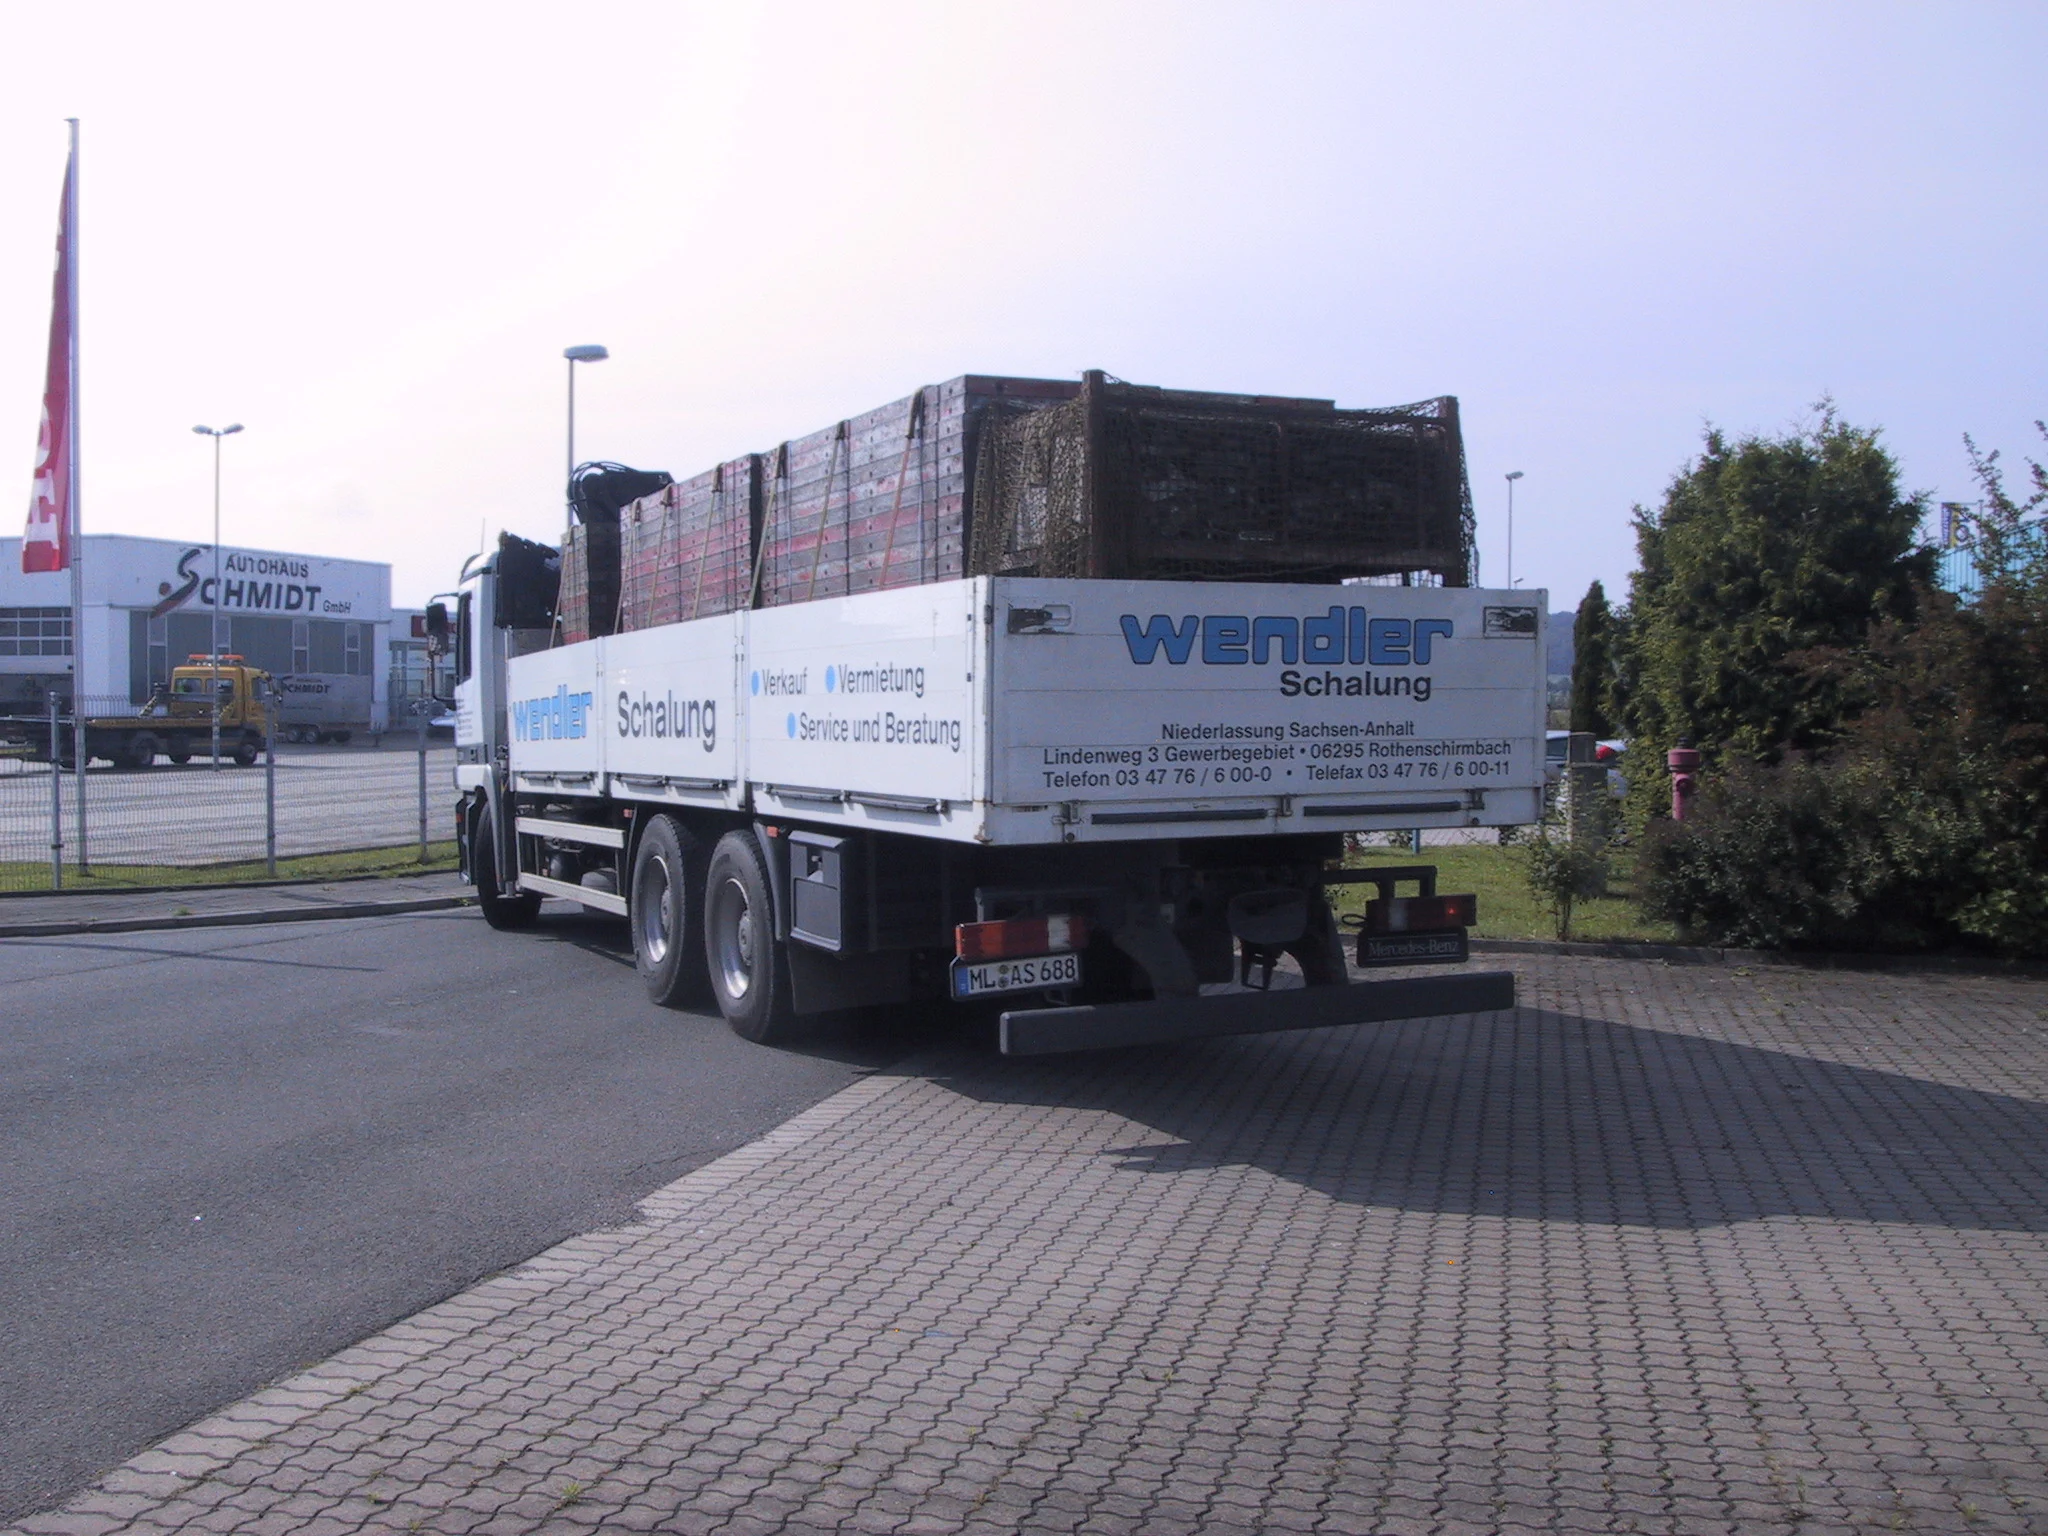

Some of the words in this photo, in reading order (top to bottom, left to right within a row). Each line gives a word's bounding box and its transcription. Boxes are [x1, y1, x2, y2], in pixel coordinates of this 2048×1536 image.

[225, 553, 310, 578] AUTOHAUS
[150, 546, 322, 620] SCHMIDT
[323, 600, 352, 614] GmbH
[1119, 606, 1454, 666] wendler
[762, 666, 808, 696] Verkauf
[838, 662, 925, 699] Vermietung
[1279, 670, 1432, 702] Schalung
[513, 683, 593, 742] wendler
[617, 689, 716, 753] Schalung
[799, 711, 849, 743] Service
[852, 712, 880, 742] und
[884, 712, 961, 753] Beratung
[1161, 723, 1285, 741] Niederlassung
[1289, 720, 1415, 738] Sachsen-Anhalt
[1043, 748, 1143, 767] Lindenweg
[1147, 746, 1159, 763] 3
[1164, 744, 1295, 764] Gewerbegebiet
[1310, 742, 1364, 759] 06295
[1369, 739, 1512, 758] Rothenschirmbach
[1043, 770, 1110, 788] Telefon
[1115, 769, 1139, 786] 03
[1145, 768, 1168, 785] 47
[1173, 767, 1196, 784] 76
[1213, 766, 1225, 783] 6
[1229, 765, 1272, 783] 00-0
[1305, 764, 1363, 780] Telefax
[1367, 763, 1388, 779] 03
[1393, 763, 1413, 778] 47
[1418, 762, 1438, 777] 76
[1454, 761, 1464, 777] 6
[1468, 760, 1510, 776] 00-11
[1368, 938, 1460, 957] Mercedes-Benz
[969, 967, 996, 990] ML
[1010, 963, 1035, 985] AS
[1040, 958, 1076, 981] 688
